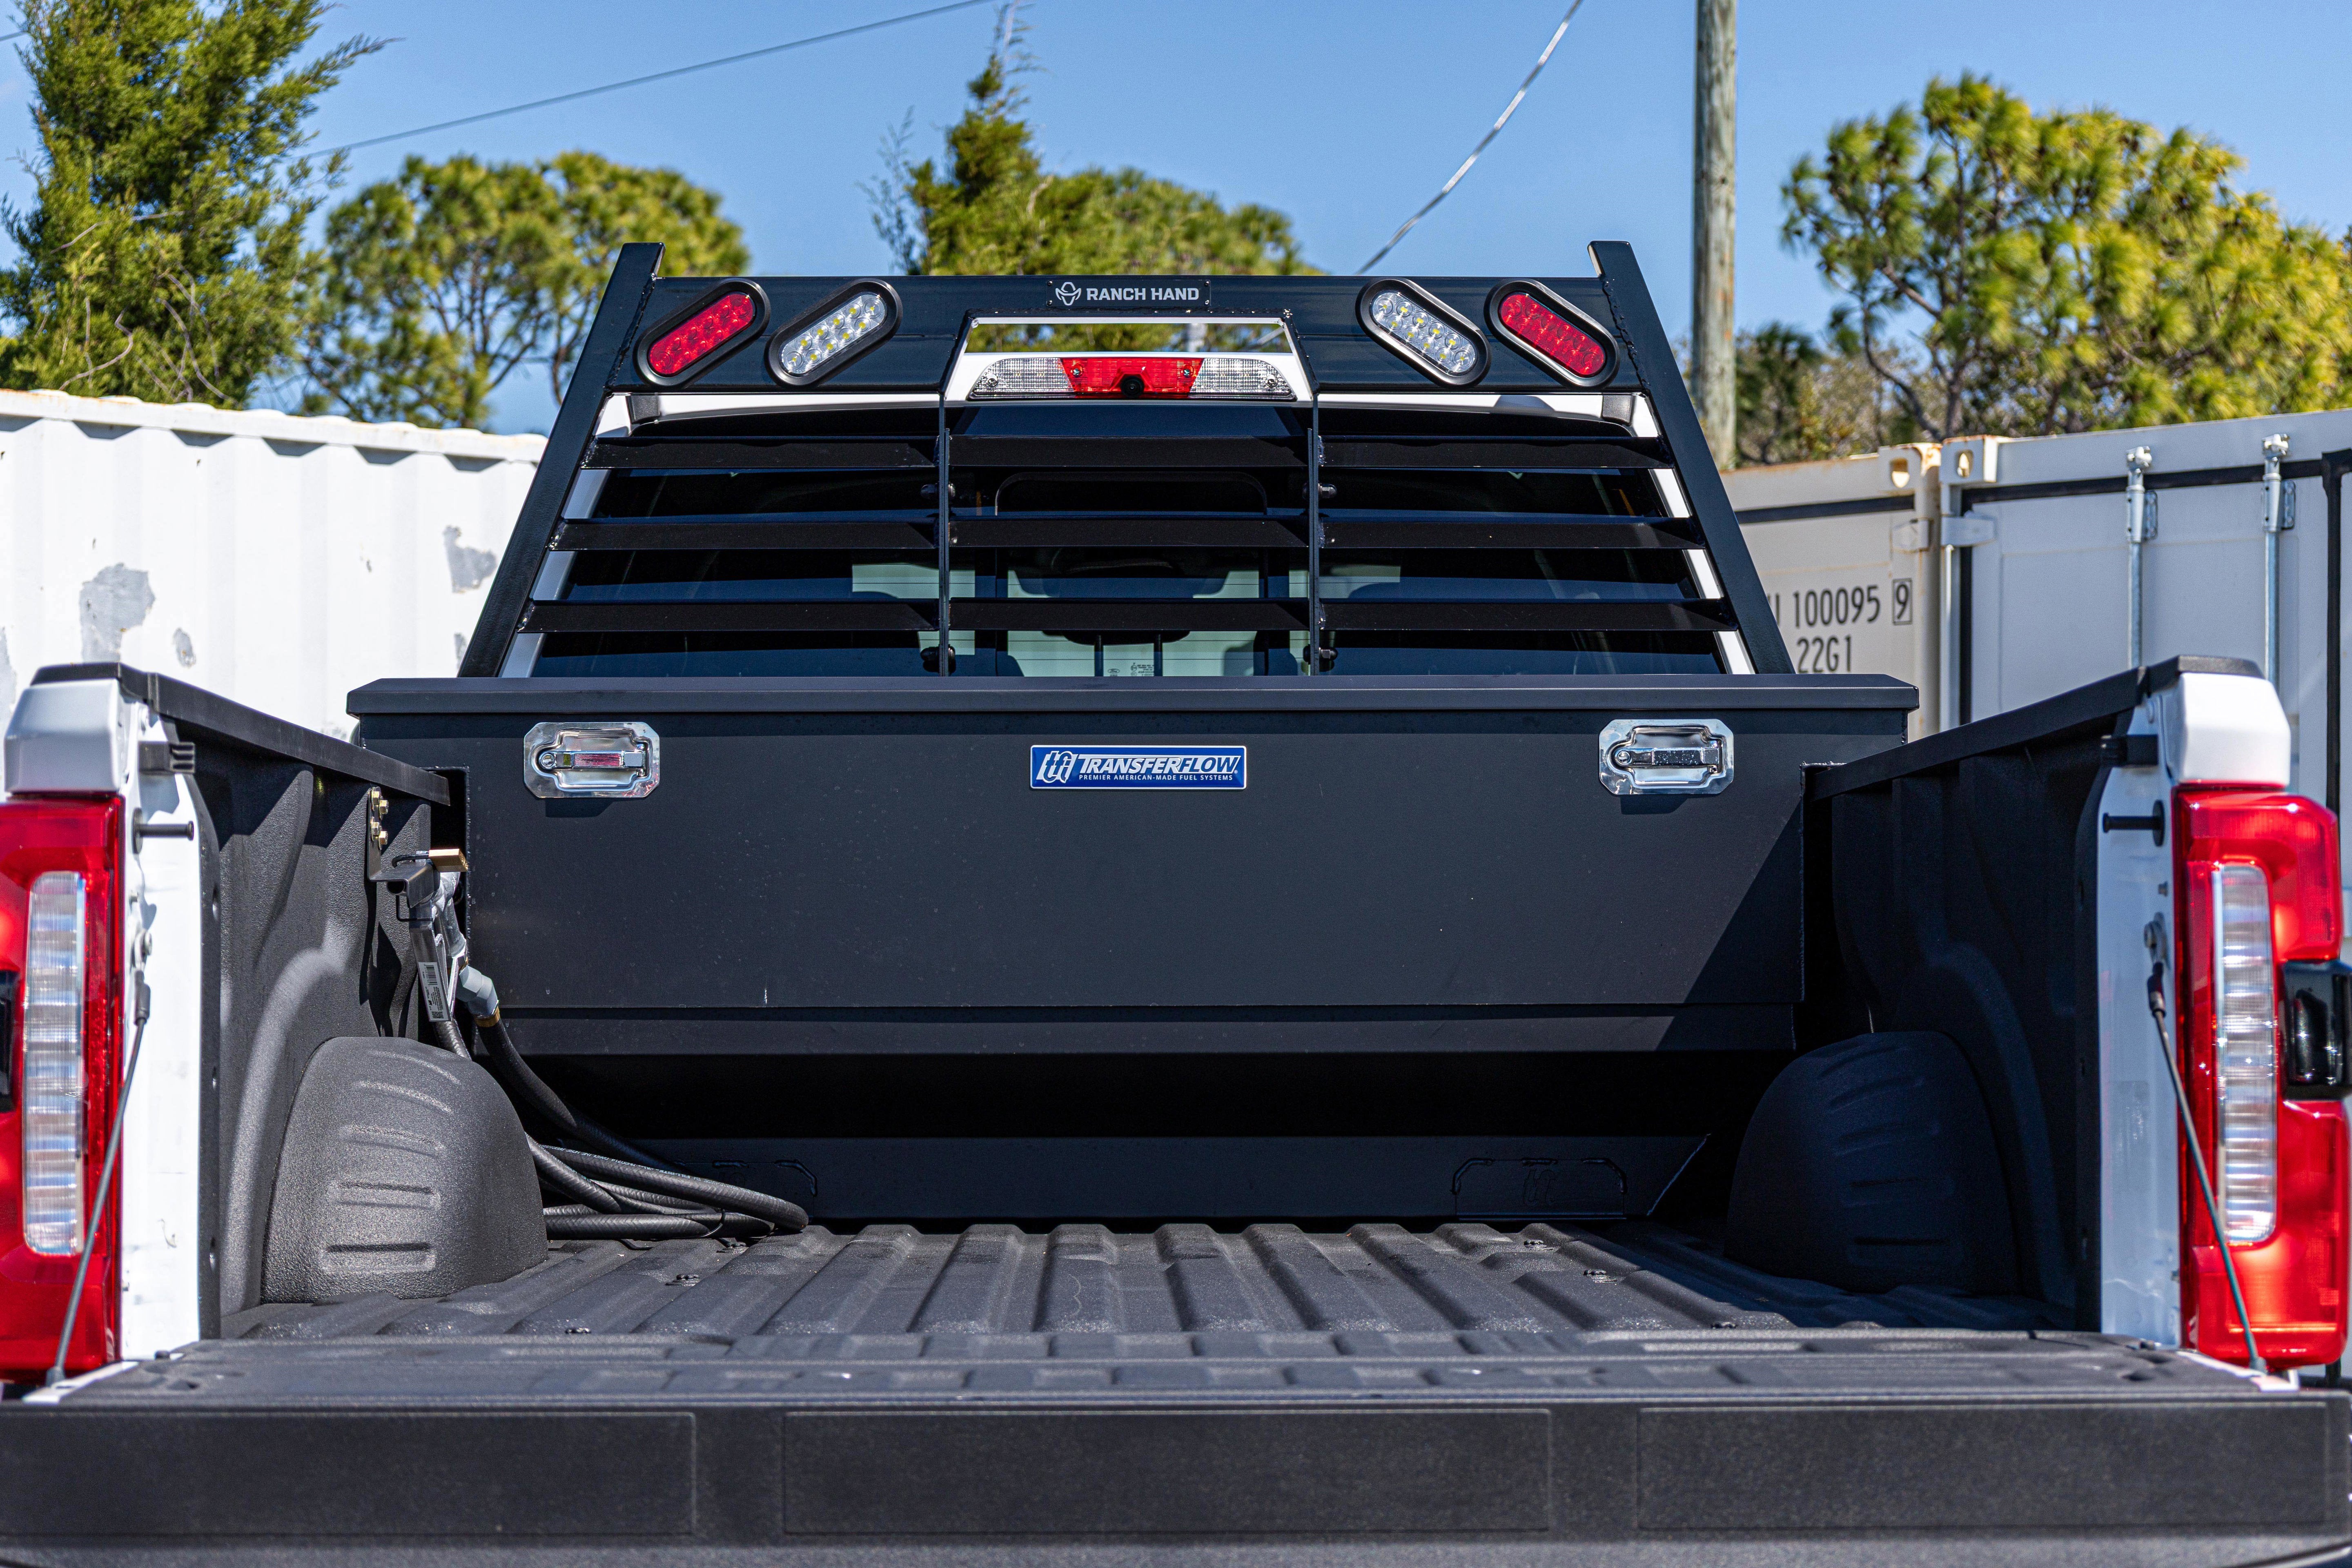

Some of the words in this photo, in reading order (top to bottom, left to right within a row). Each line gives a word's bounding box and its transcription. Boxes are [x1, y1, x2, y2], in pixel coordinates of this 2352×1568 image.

[1086, 288, 1146, 300] RANCH
[1151, 288, 1199, 300] HAND
[1793, 584, 1881, 628] 100095
[1895, 580, 1910, 620] 9
[1797, 634, 1852, 673] 22G1
